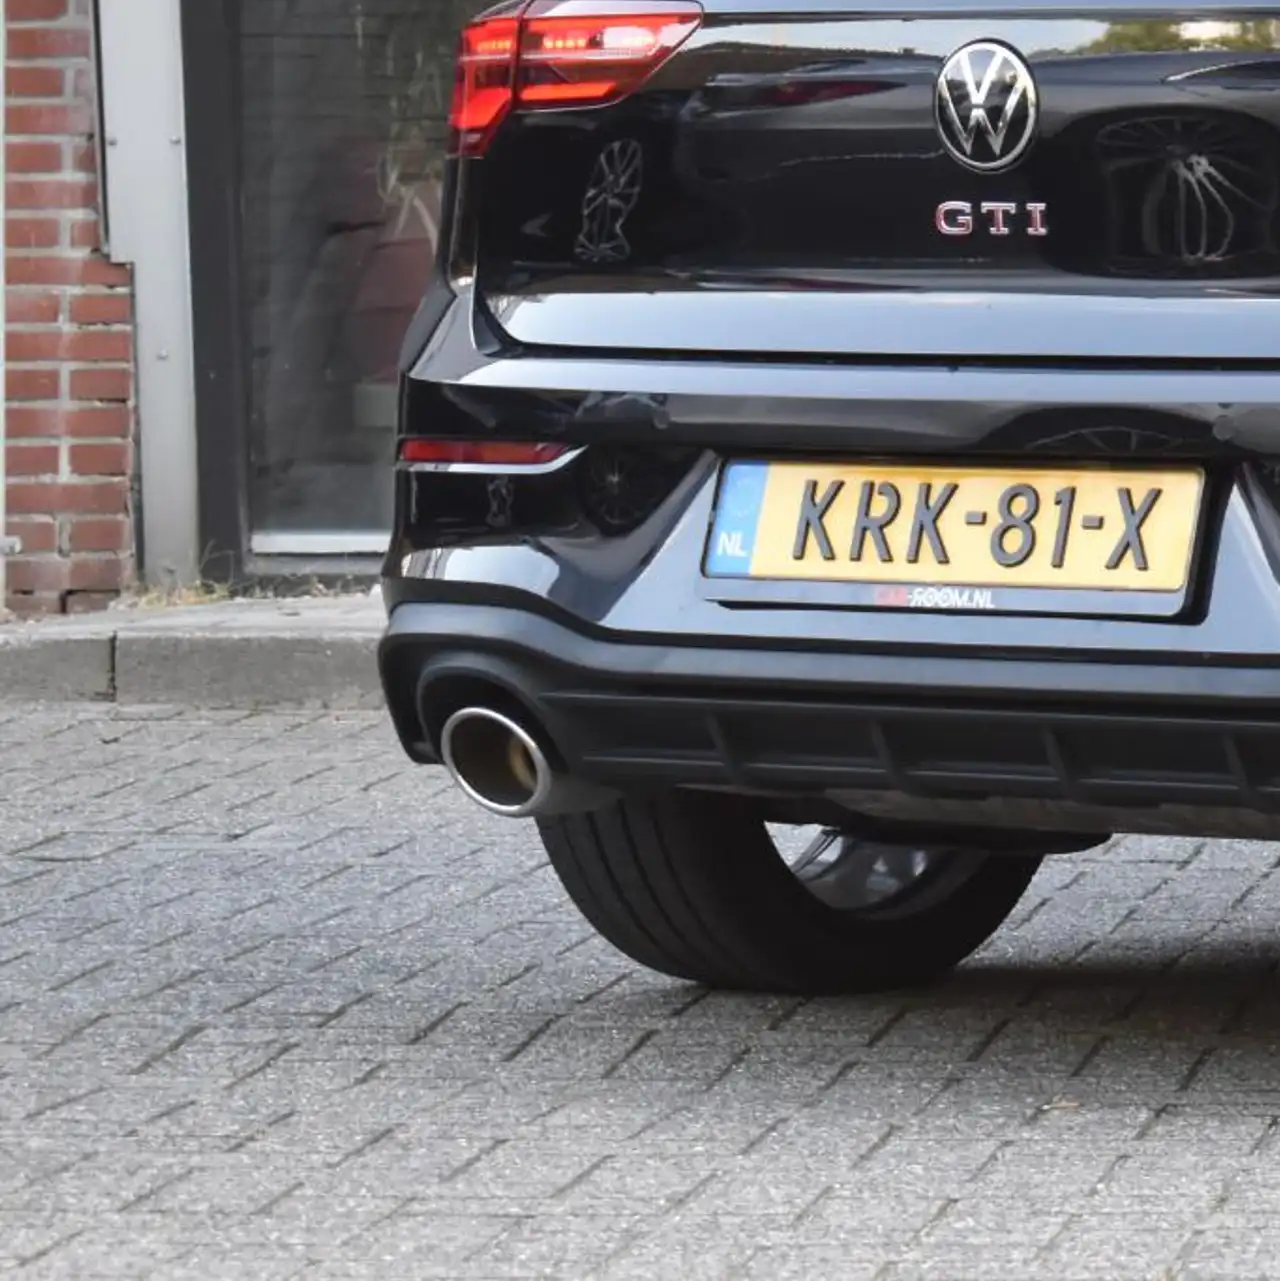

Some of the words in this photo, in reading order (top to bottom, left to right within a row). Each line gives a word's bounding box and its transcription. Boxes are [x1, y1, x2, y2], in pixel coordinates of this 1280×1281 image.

[934, 200, 1049, 236] GTI
[791, 478, 1164, 572] KRK-81-X
[716, 530, 749, 557] NL
